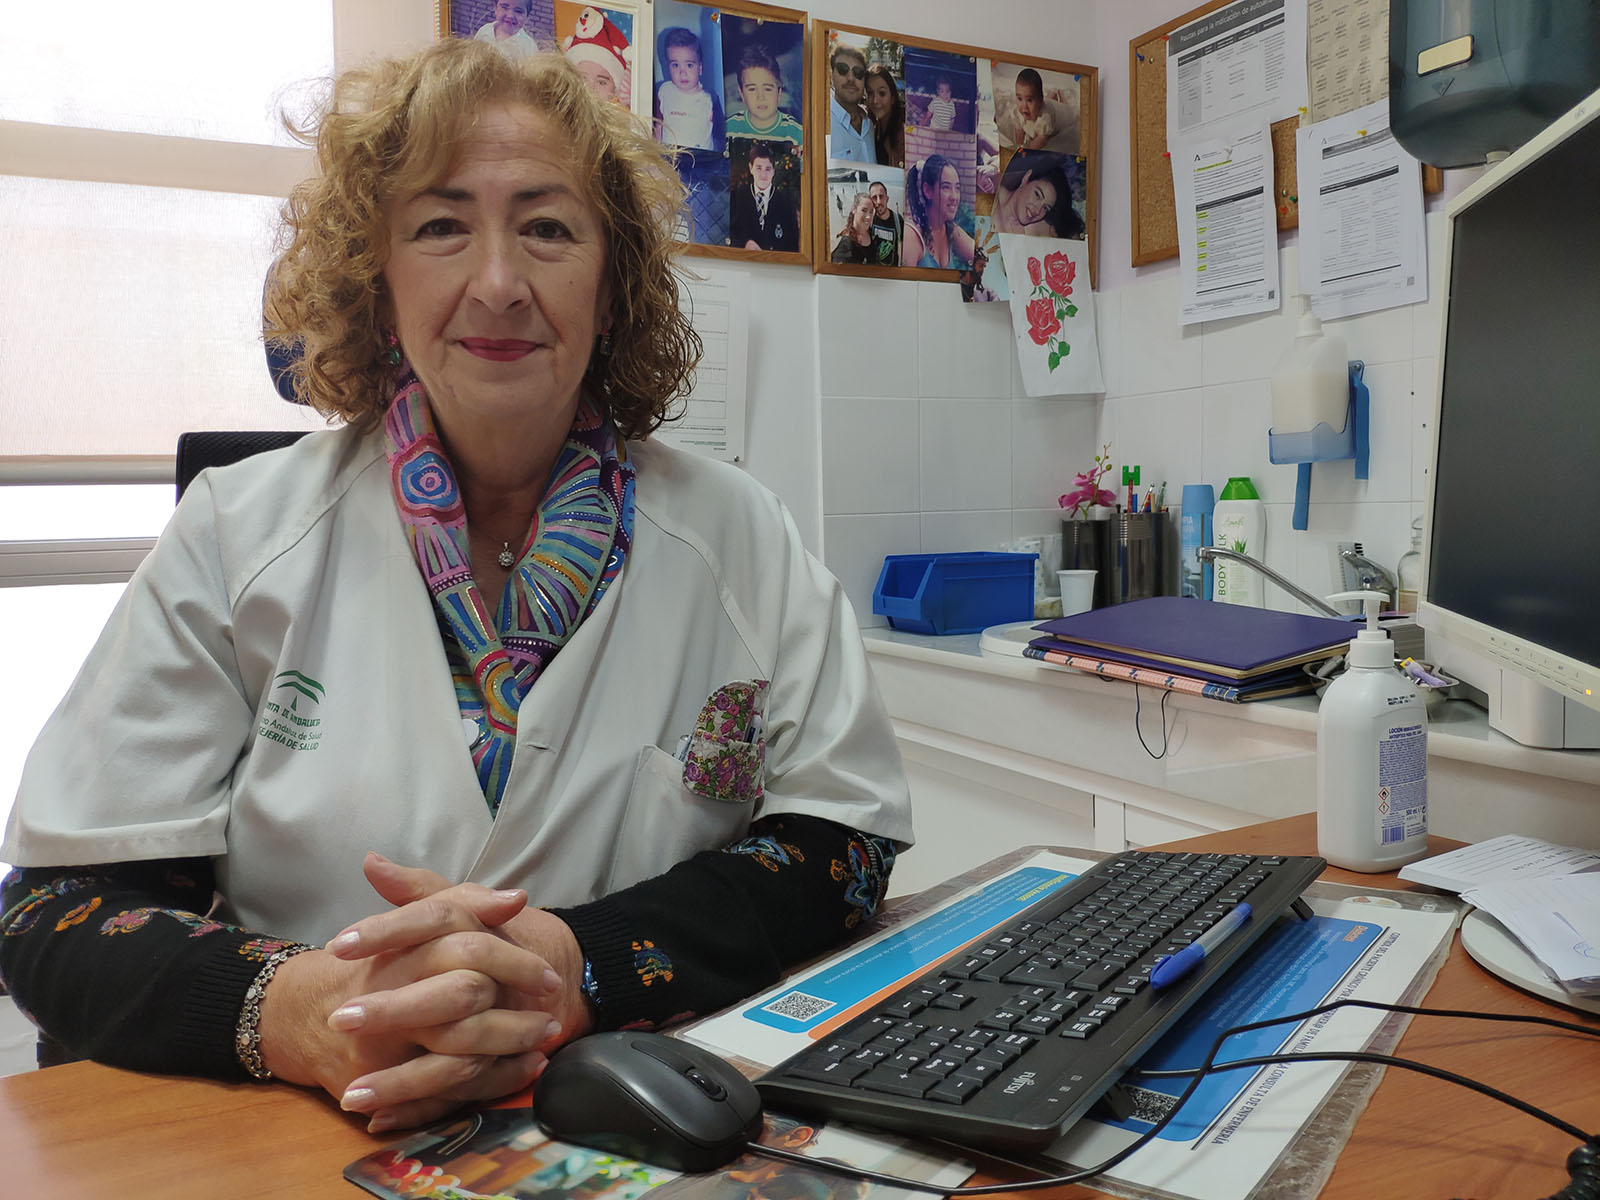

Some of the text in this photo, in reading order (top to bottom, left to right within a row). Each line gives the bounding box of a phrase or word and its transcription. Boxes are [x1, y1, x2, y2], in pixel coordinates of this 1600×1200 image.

[270, 720, 297, 738] Andaluz
[298, 732, 307, 740] de
[286, 739, 298, 750] DE
[298, 742, 319, 750] SALUD
[1003, 1072, 1036, 1094] FUJITSU
[1253, 1068, 1284, 1097] CONSULTA
[1246, 1096, 1261, 1106] DE
[1211, 1105, 1254, 1145] ENFERMERÍA
